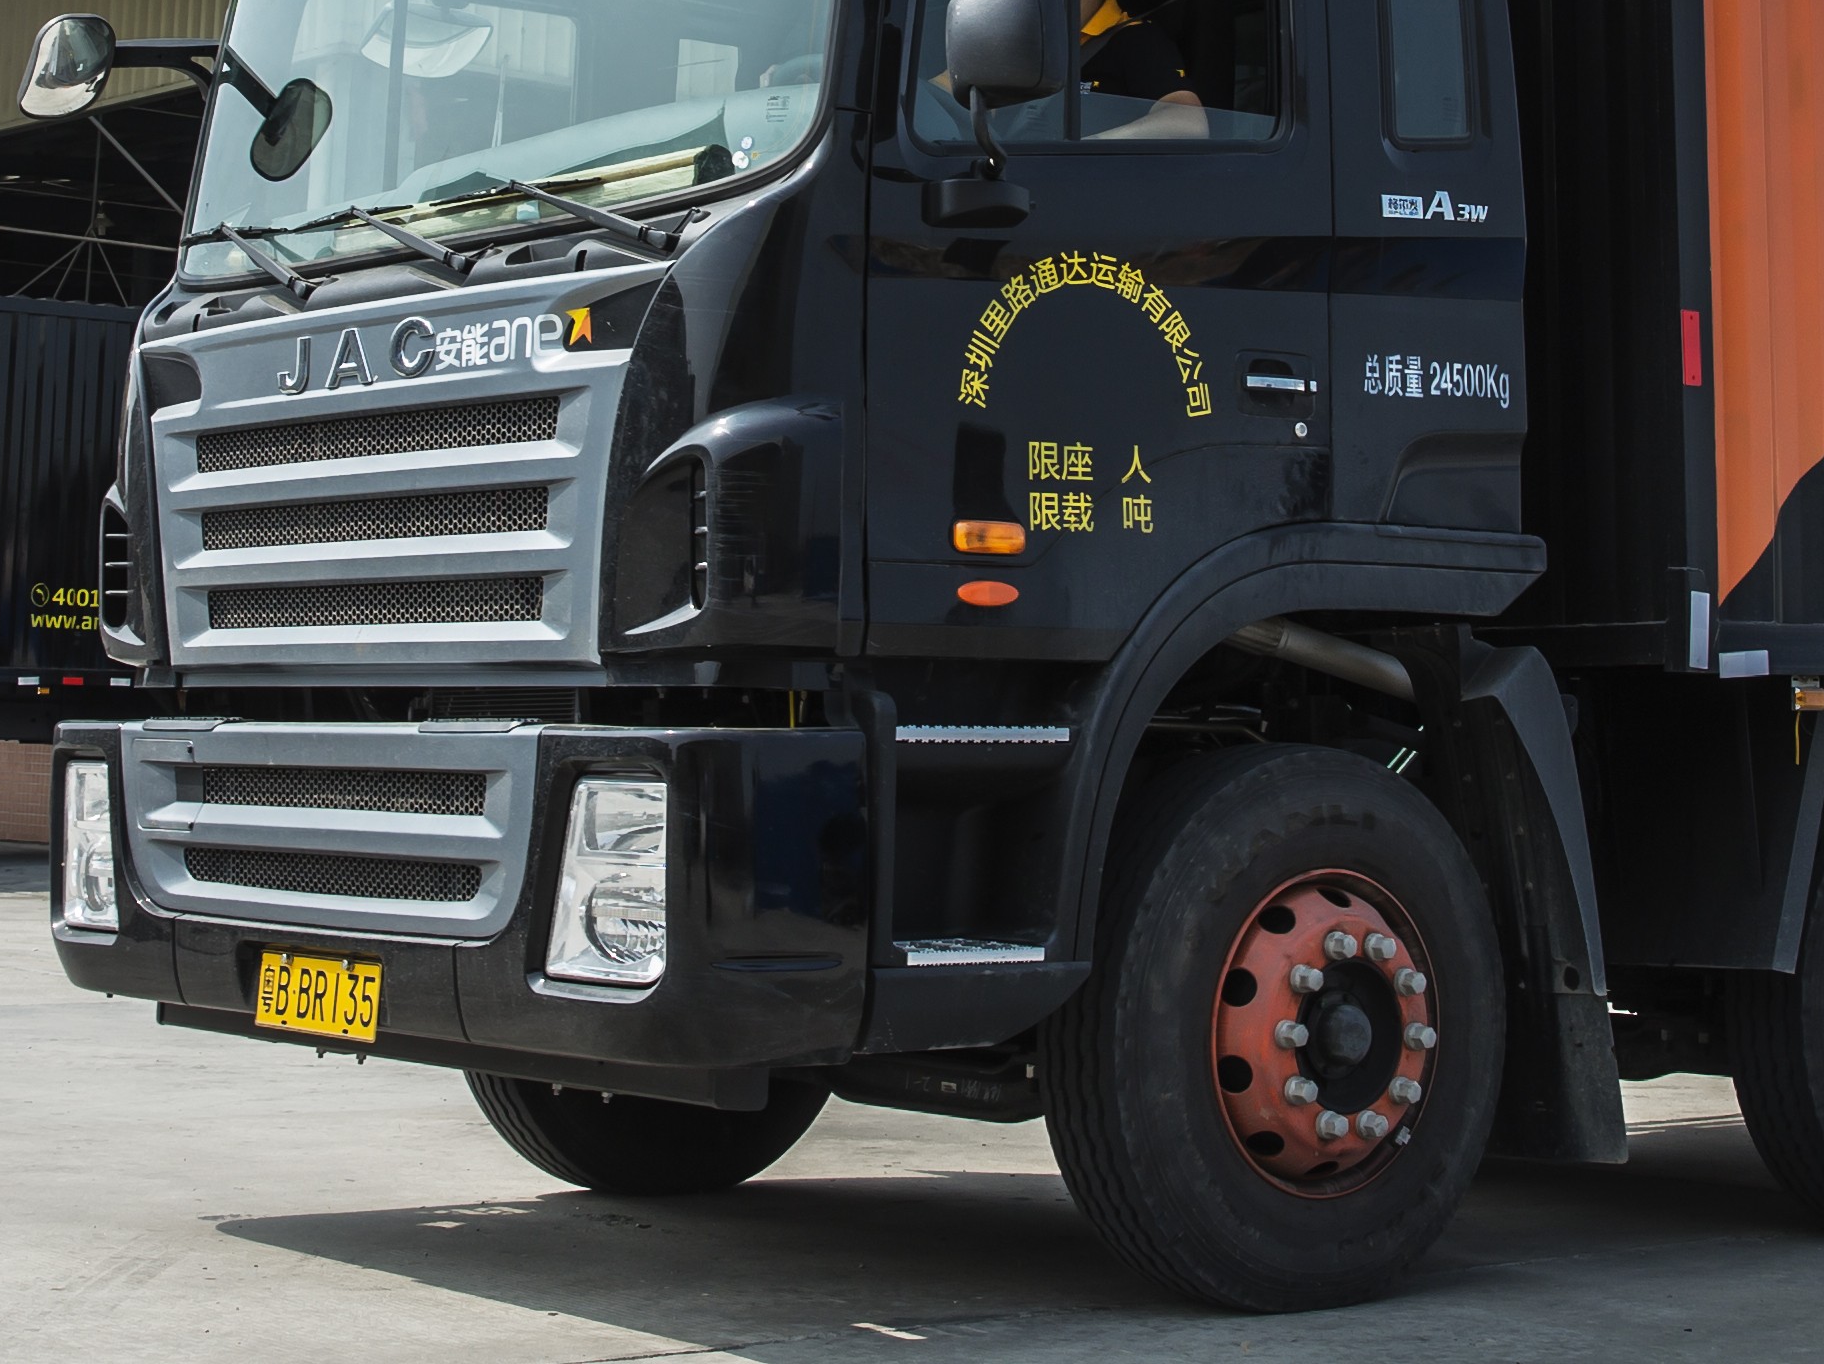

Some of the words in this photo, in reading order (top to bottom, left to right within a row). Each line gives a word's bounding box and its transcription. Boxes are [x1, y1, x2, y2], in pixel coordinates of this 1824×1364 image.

[277, 315, 436, 395] JAC
[957, 250, 1212, 418] 深圳里路通达运输有限公司
[1363, 353, 1425, 398] 总质量
[1429, 361, 1510, 409] 24500Kg
[1028, 441, 1094, 481] 限座
[1121, 444, 1152, 484] 人
[1029, 491, 1095, 533] 限载
[1122, 493, 1154, 534] 吨
